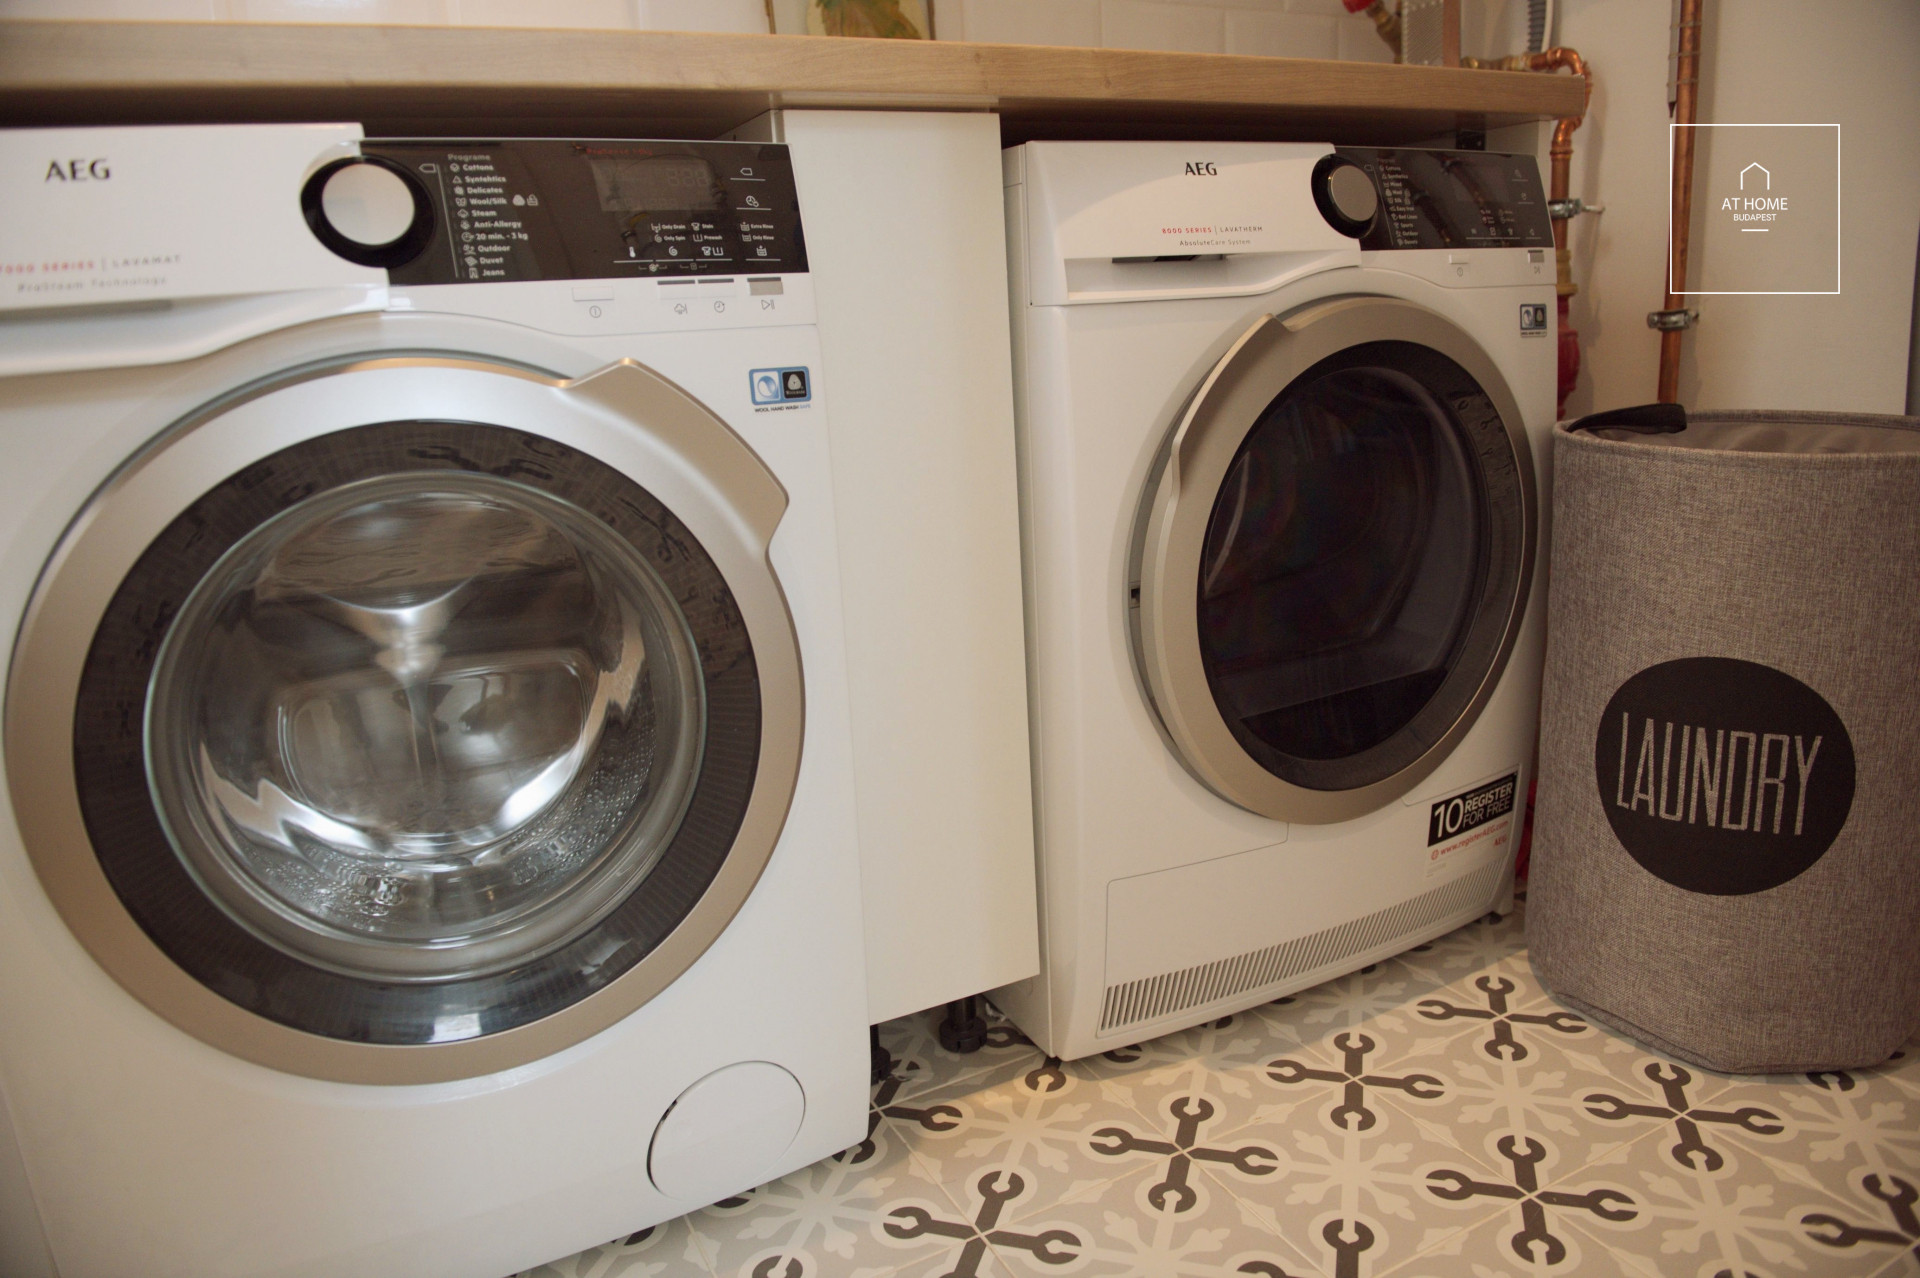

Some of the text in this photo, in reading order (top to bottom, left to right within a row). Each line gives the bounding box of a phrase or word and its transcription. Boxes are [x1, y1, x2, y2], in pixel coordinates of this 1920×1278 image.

[45, 158, 111, 182] AEG
[462, 163, 494, 172] Cottons
[1184, 161, 1218, 176] AEG
[466, 186, 504, 194] Delicates
[469, 197, 508, 205] Wool/Silk
[471, 209, 498, 217] Steam
[474, 220, 522, 229] Anti-Allergy
[1185, 226, 1212, 234] SERIES
[1220, 225, 1263, 233] LAVATHERM
[475, 232, 487, 240] 20
[517, 231, 529, 241] kg
[477, 244, 511, 253] Outdoor
[479, 256, 504, 265] Duvet
[482, 269, 506, 277] Jeans
[1616, 711, 1823, 836] LAUNDRY
[1464, 782, 1514, 814] REGISTER
[1462, 795, 1511, 829] FOR FREE
[1434, 797, 1465, 838] 10
